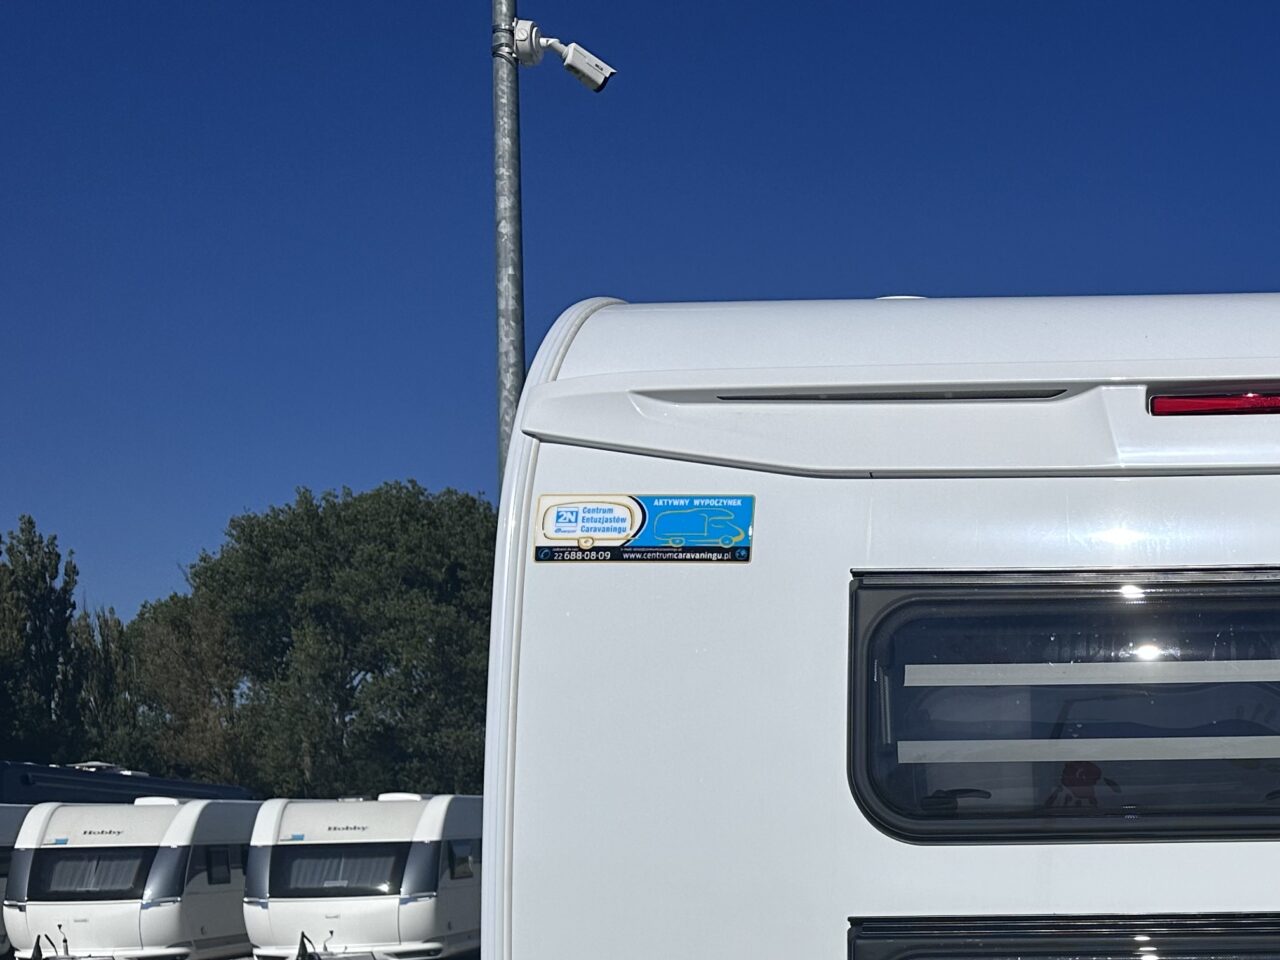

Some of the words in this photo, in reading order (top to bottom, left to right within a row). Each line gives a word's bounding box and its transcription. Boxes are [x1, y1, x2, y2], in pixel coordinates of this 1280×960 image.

[653, 498, 690, 507] AKTYWNY
[693, 498, 742, 507] WYPOCZYNEK
[582, 506, 614, 515] Centrum
[557, 511, 577, 523] 2N
[581, 516, 627, 525] Entuzjastów
[580, 526, 627, 535] Caravaningu
[622, 551, 732, 561] www.centrumcaravaningu.pl
